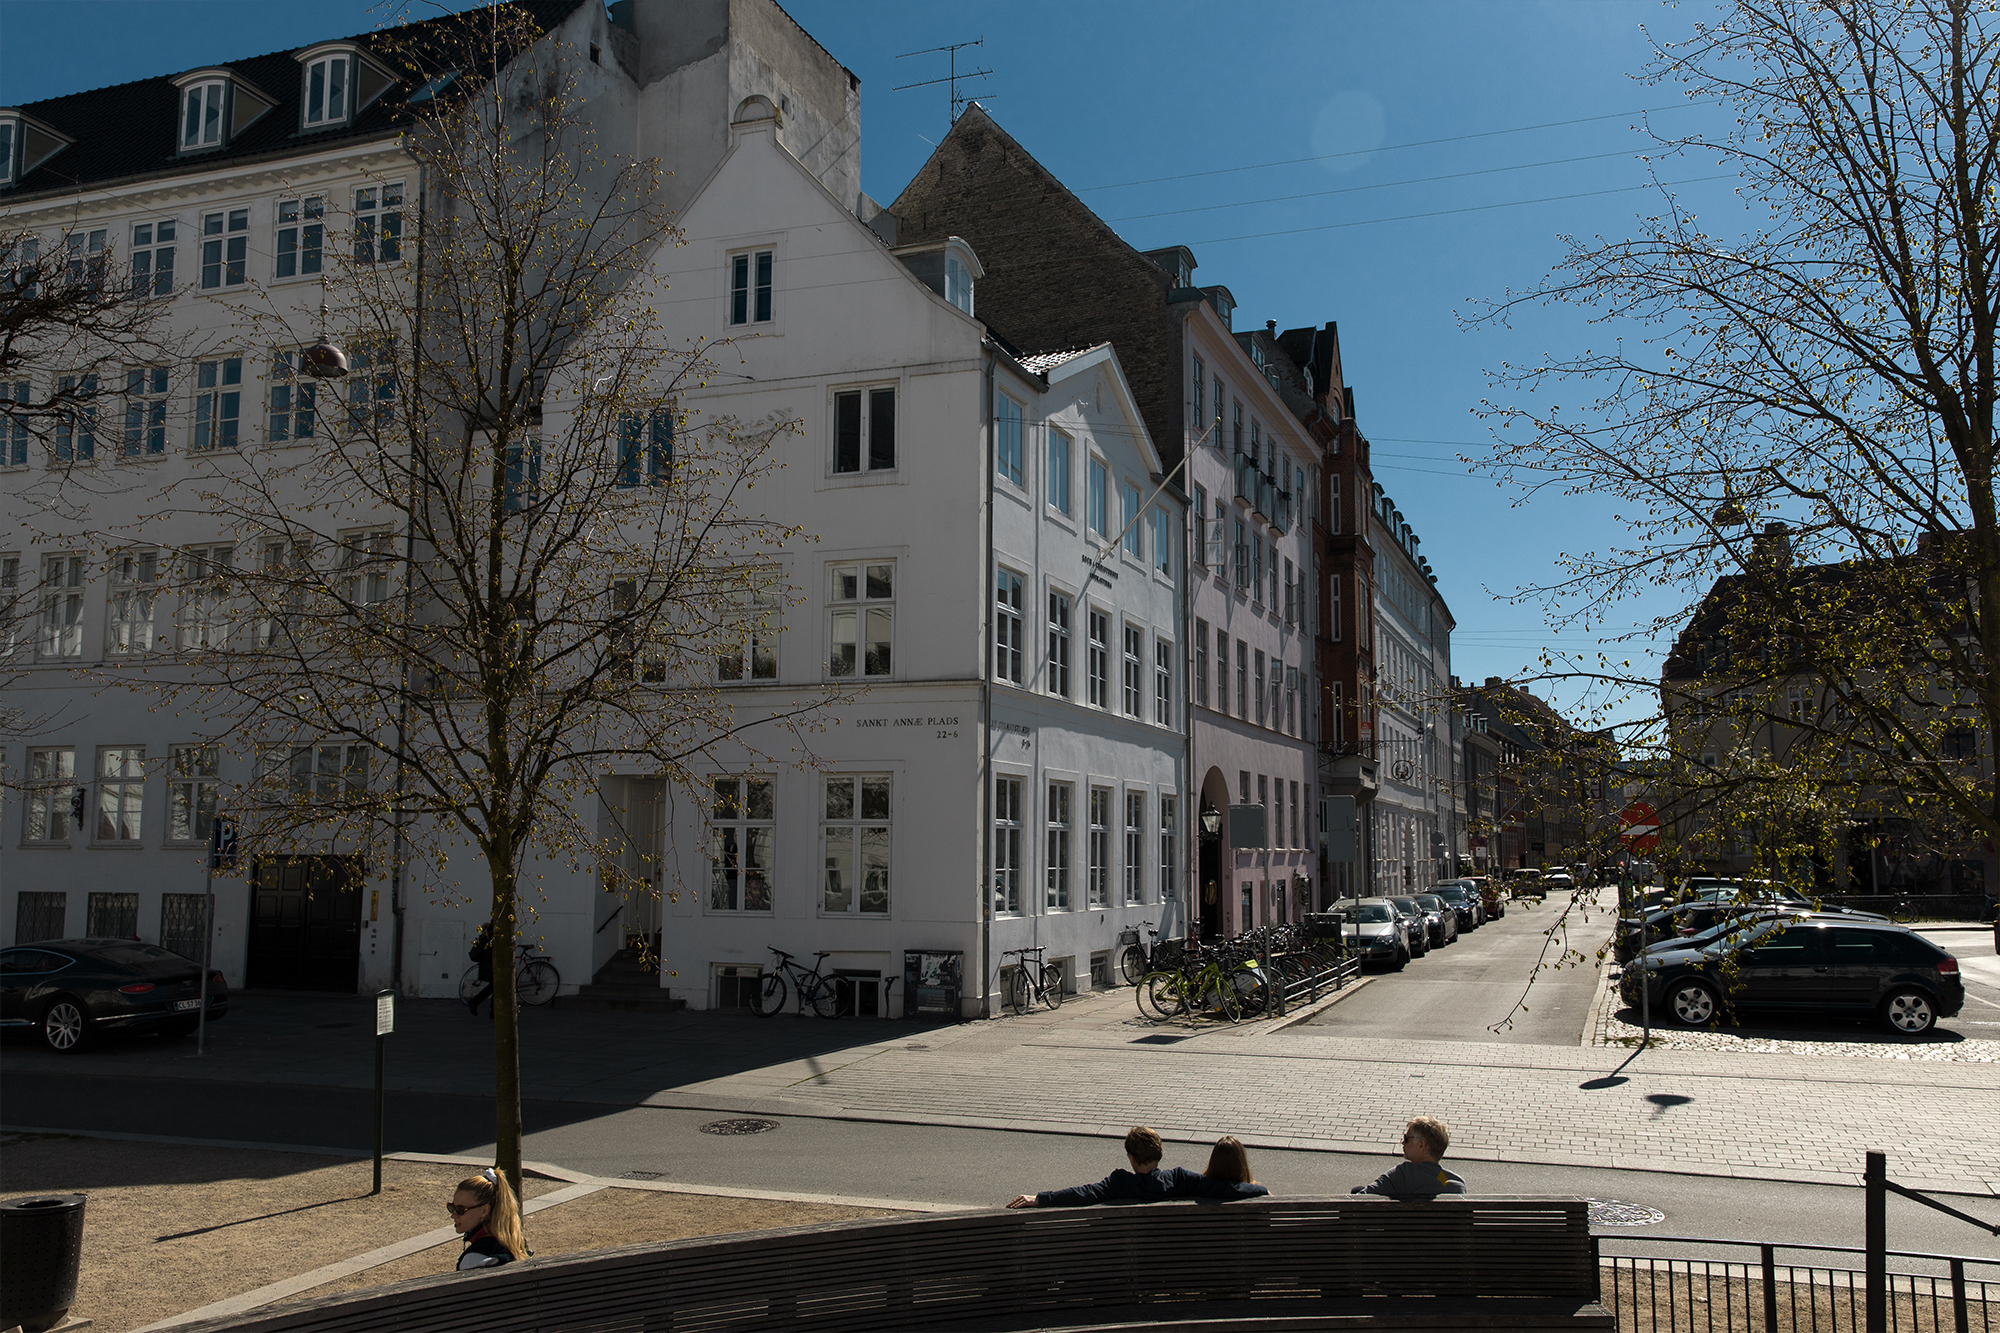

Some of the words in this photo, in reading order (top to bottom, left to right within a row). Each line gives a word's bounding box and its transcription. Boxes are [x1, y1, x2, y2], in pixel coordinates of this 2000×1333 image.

[856, 719, 888, 728] SANKT
[892, 717, 923, 727] ANNÆ
[927, 716, 959, 726] PLADS
[936, 730, 959, 739] 22-6
[220, 821, 234, 850] P
[574, 863, 580, 872] 6
